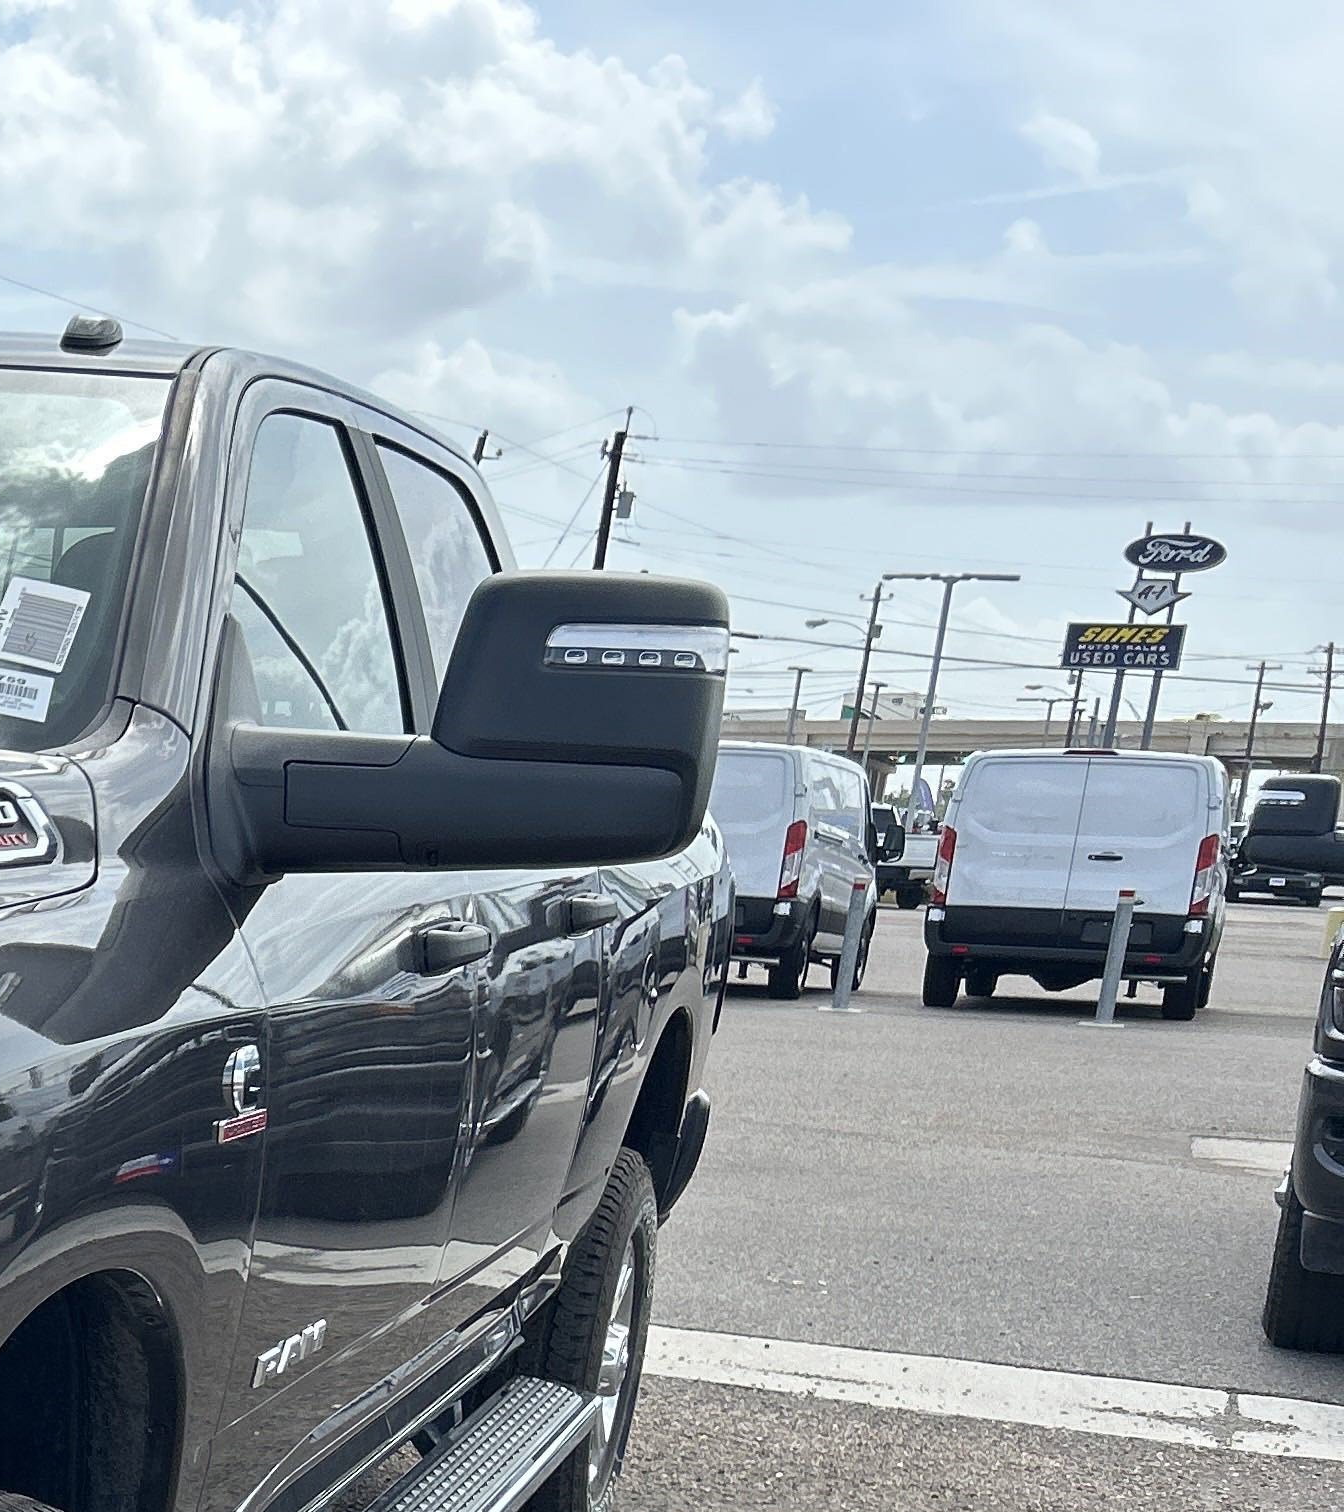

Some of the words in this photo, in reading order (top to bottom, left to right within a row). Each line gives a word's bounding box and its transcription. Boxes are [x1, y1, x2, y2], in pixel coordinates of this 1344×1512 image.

[1137, 538, 1215, 566] Ford
[1078, 627, 1170, 643] SAMES
[1069, 651, 1116, 665] USED
[1123, 652, 1171, 666] CARS
